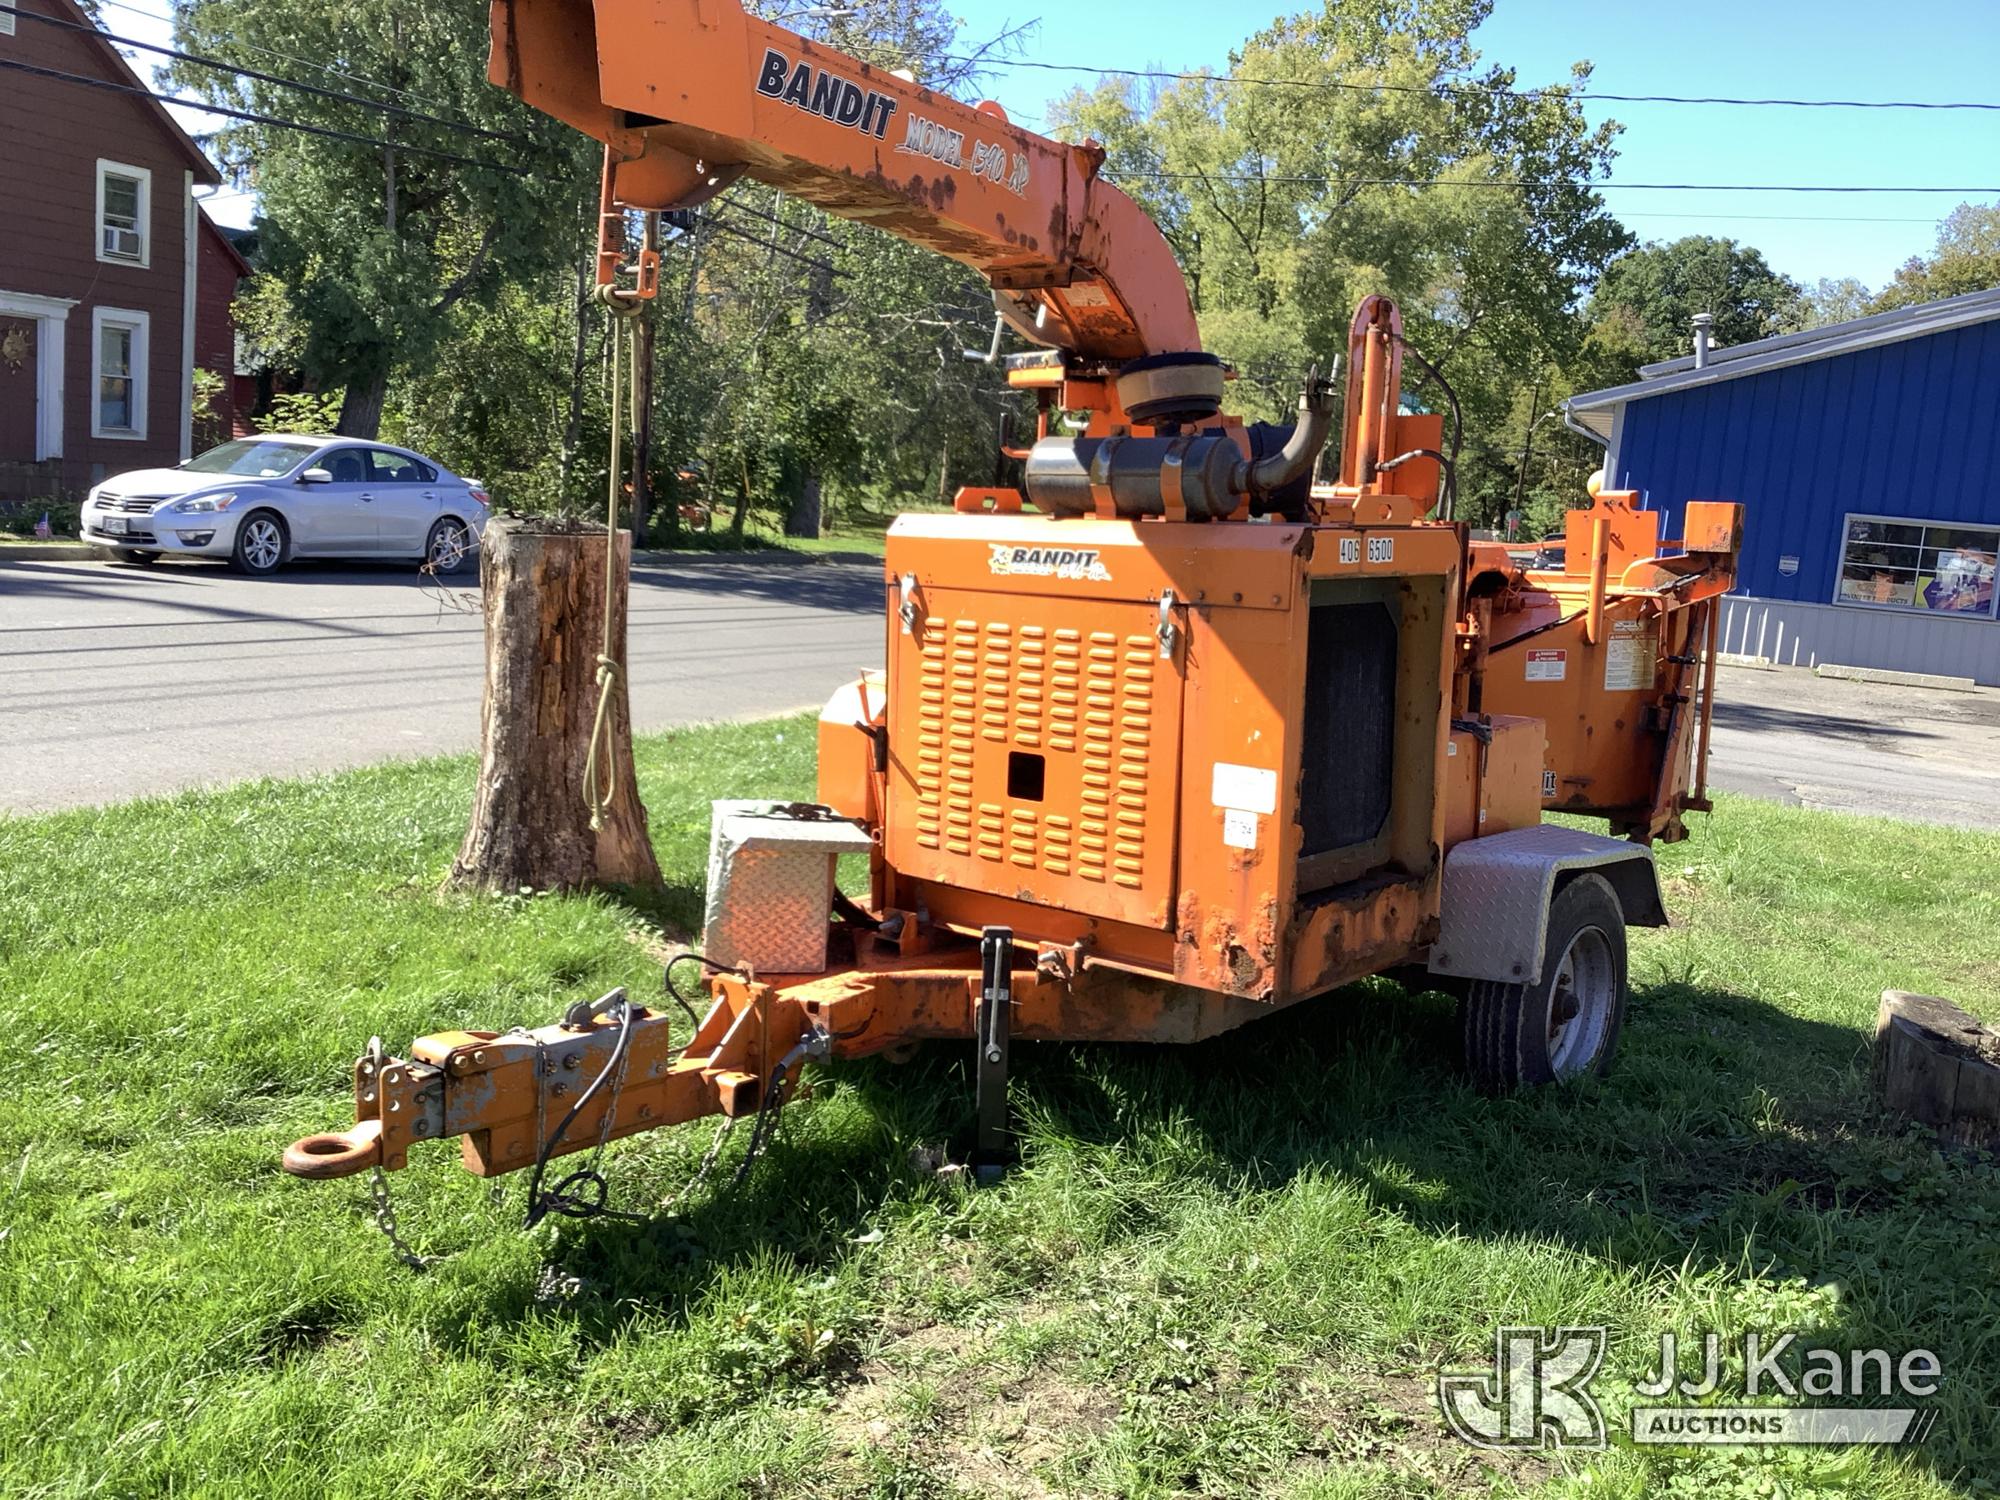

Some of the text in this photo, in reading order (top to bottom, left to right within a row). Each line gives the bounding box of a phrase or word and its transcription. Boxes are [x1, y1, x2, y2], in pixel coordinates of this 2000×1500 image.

[756, 47, 898, 141] BANDIT
[905, 112, 964, 170] MODEL
[1010, 548, 1098, 568] BANDIT
[1340, 539, 1392, 562] 406 6500
